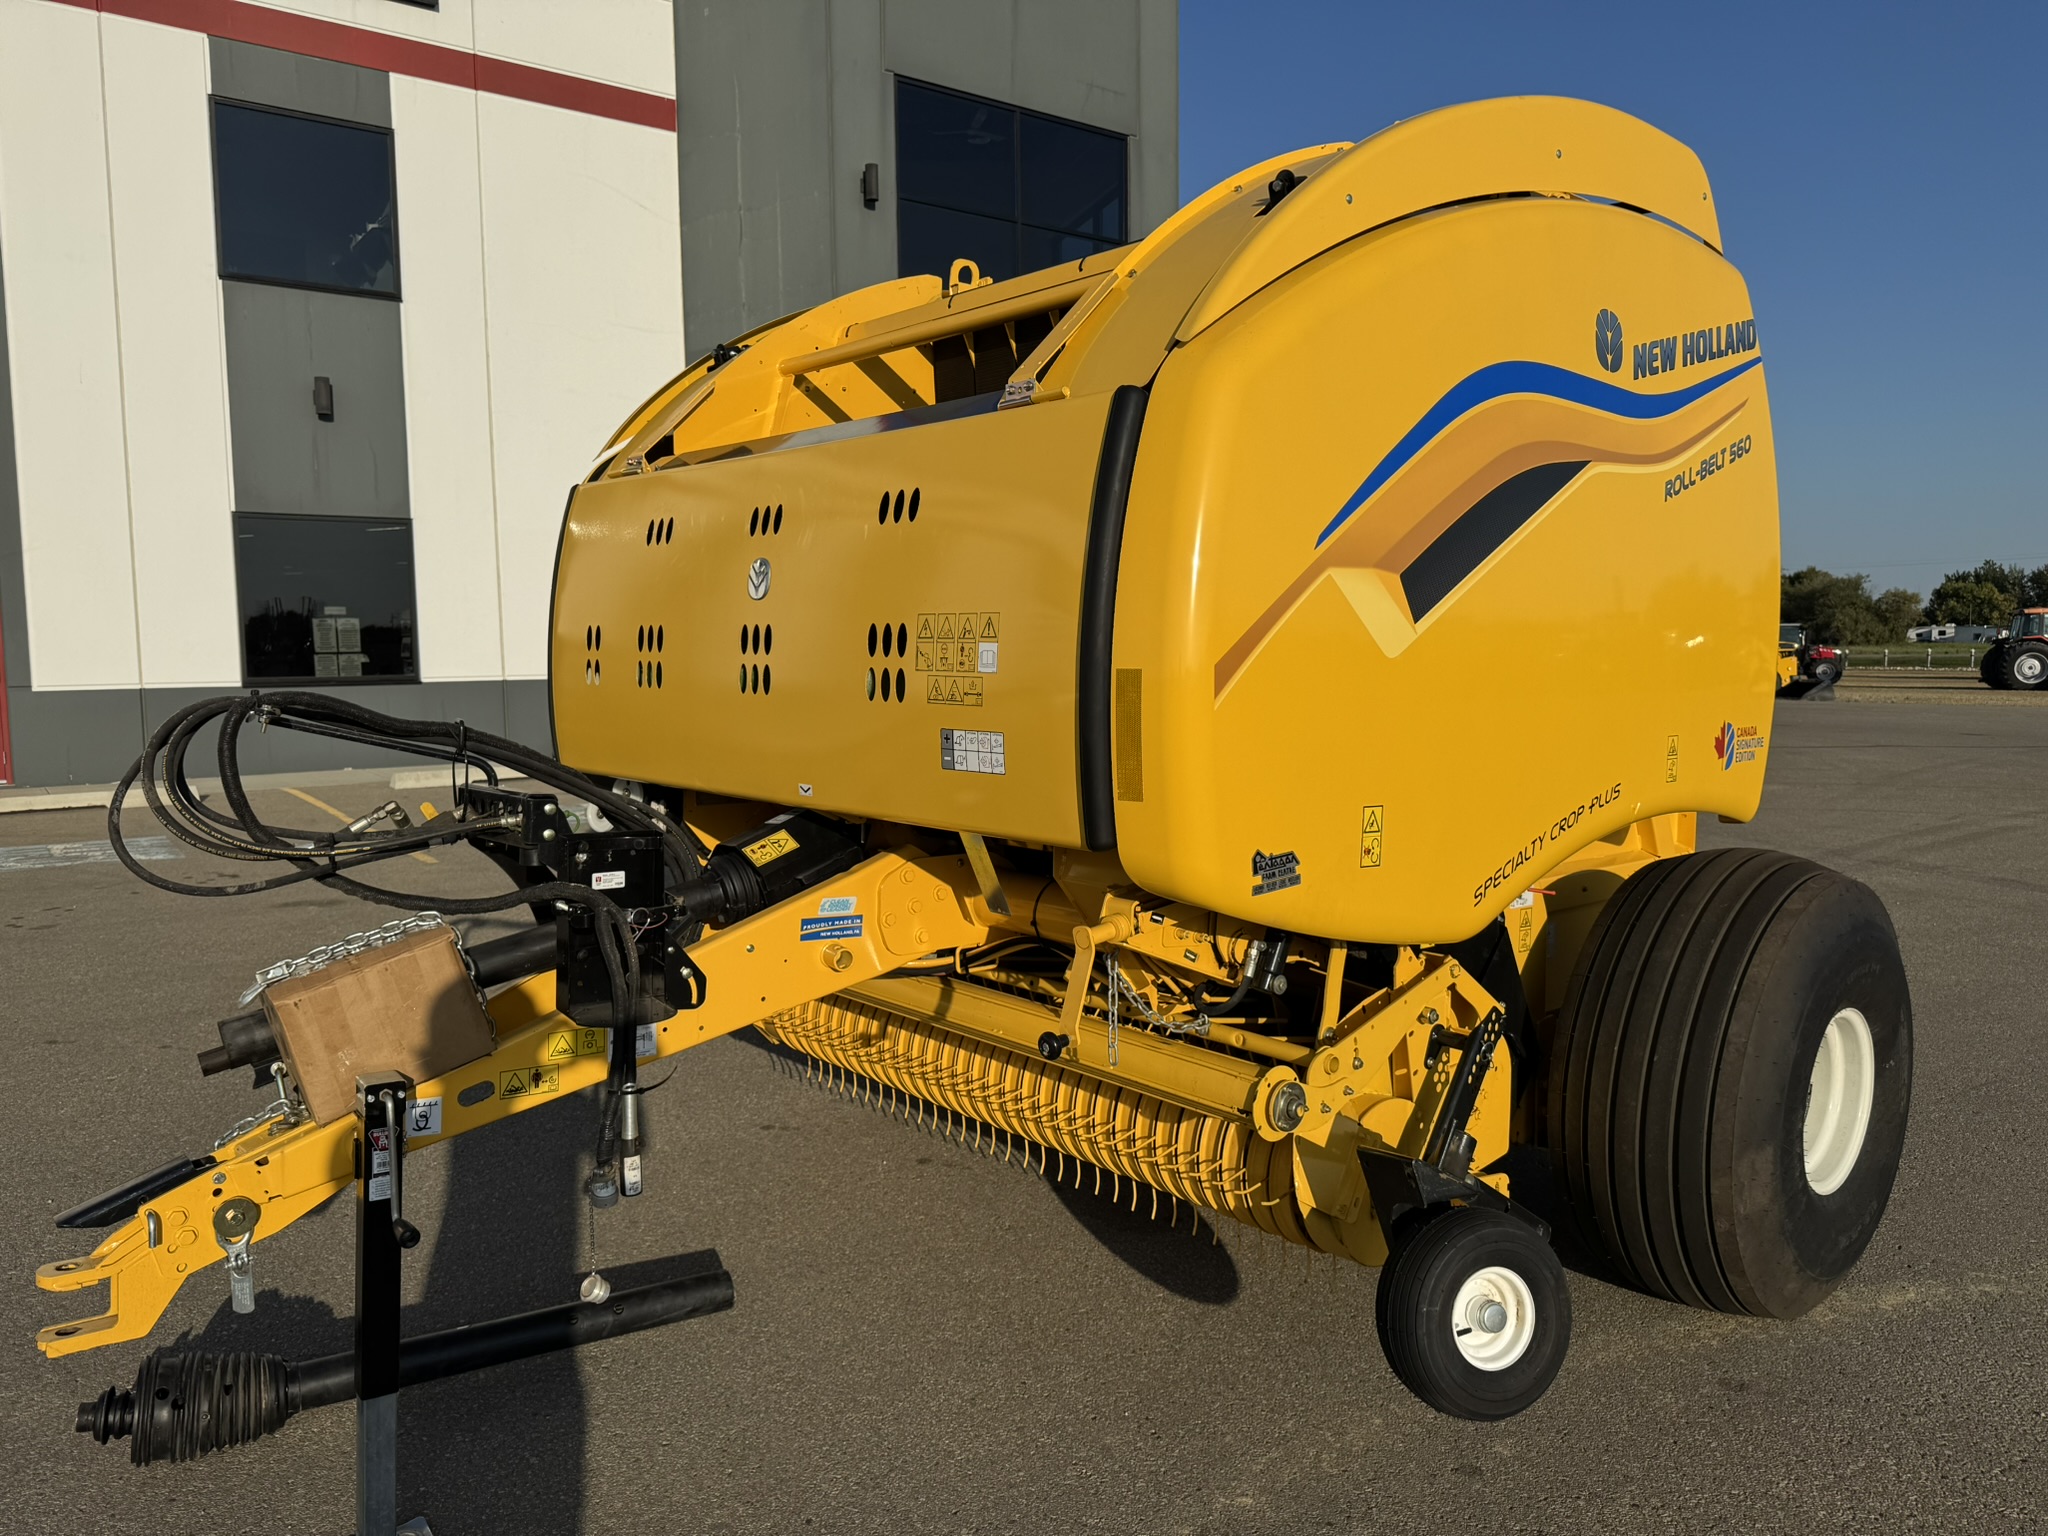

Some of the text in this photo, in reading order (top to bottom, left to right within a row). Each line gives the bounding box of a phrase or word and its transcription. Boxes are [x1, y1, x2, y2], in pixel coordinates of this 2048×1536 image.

[1633, 318, 1757, 380] NEW HOLLAND
[1664, 434, 1752, 502] ROLL-BELT 560
[1736, 725, 1758, 738] CANADA
[1736, 736, 1765, 750] SIGNATURE
[1735, 750, 1756, 763] EDITION
[1473, 783, 1622, 907] SPECIALTY CROP PLUS
[803, 921, 832, 930] PROUDLY
